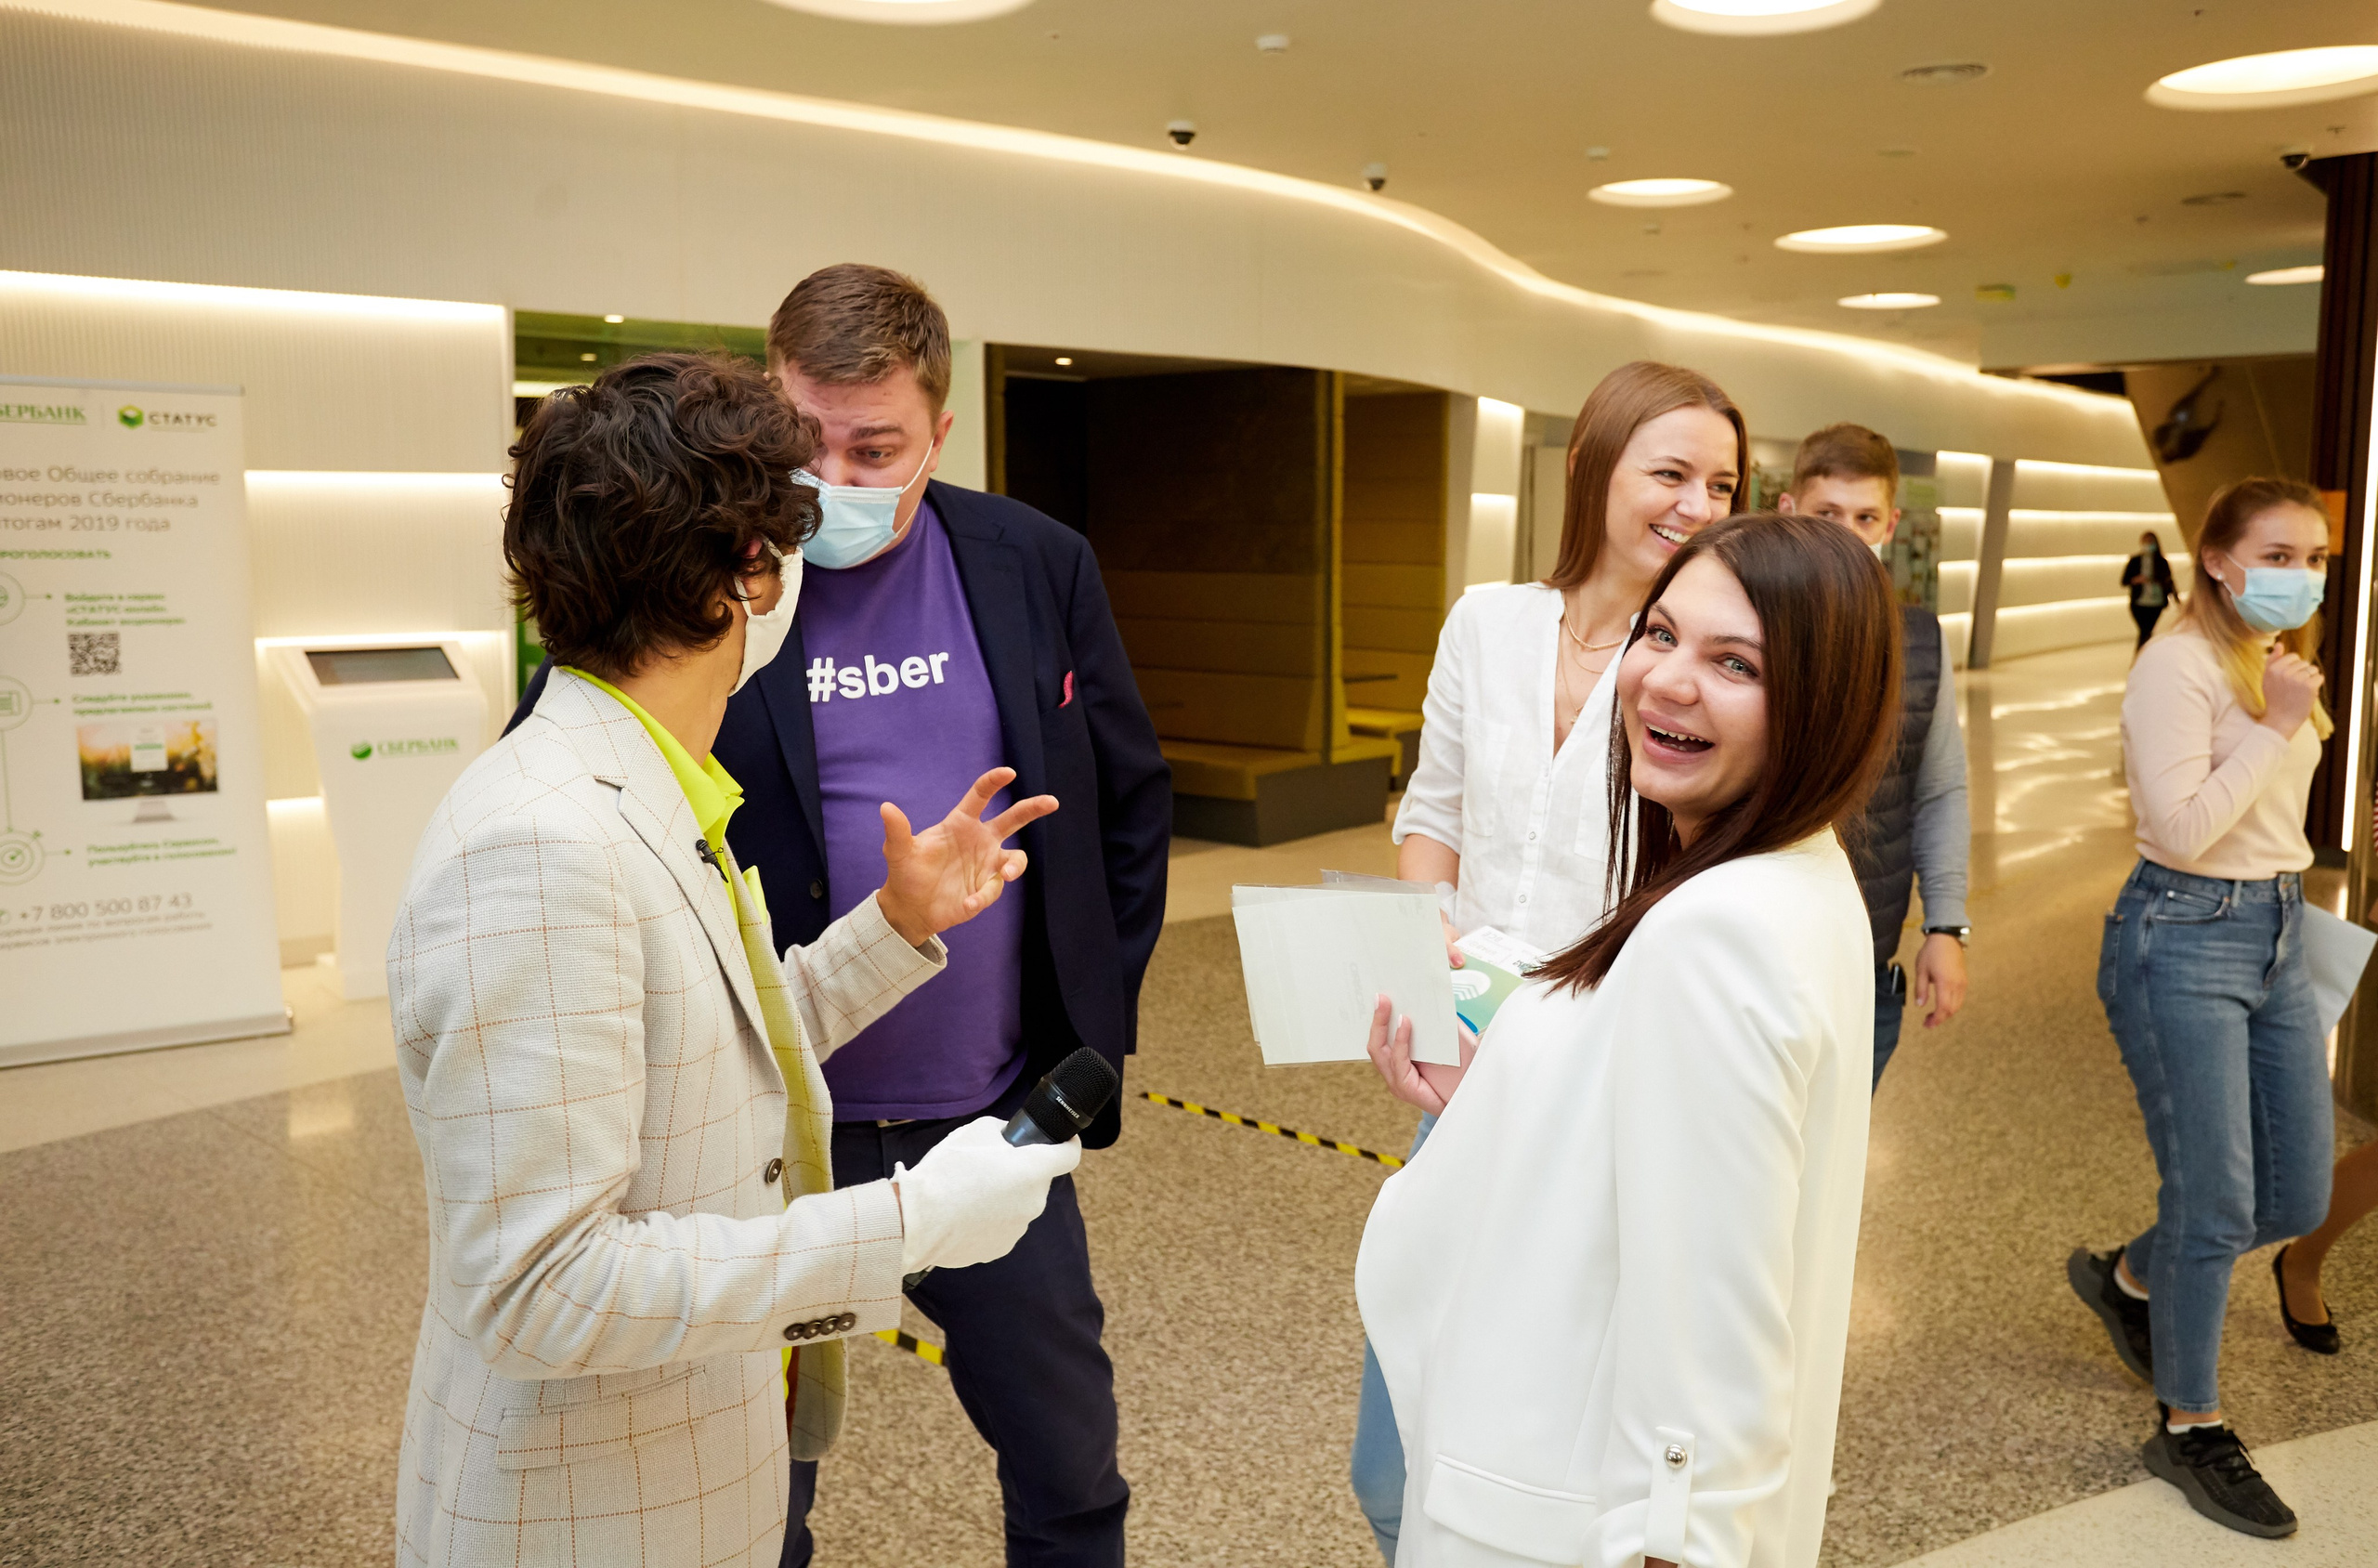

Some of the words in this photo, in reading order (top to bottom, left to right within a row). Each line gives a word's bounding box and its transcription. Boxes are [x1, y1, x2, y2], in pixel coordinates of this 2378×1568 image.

[148, 412, 218, 427] СТАТУС
[0, 467, 41, 481] вое
[47, 464, 118, 483] Общее
[124, 467, 220, 486] собрание
[0, 493, 82, 507] онеров
[88, 492, 198, 509] Сбербанка
[69, 515, 120, 531] 2019
[124, 518, 171, 533] года
[805, 651, 950, 703] #sber
[20, 905, 44, 922] +7
[49, 900, 89, 921] 800
[94, 896, 134, 917] 500
[137, 894, 163, 912] 87
[167, 891, 193, 909] 43
